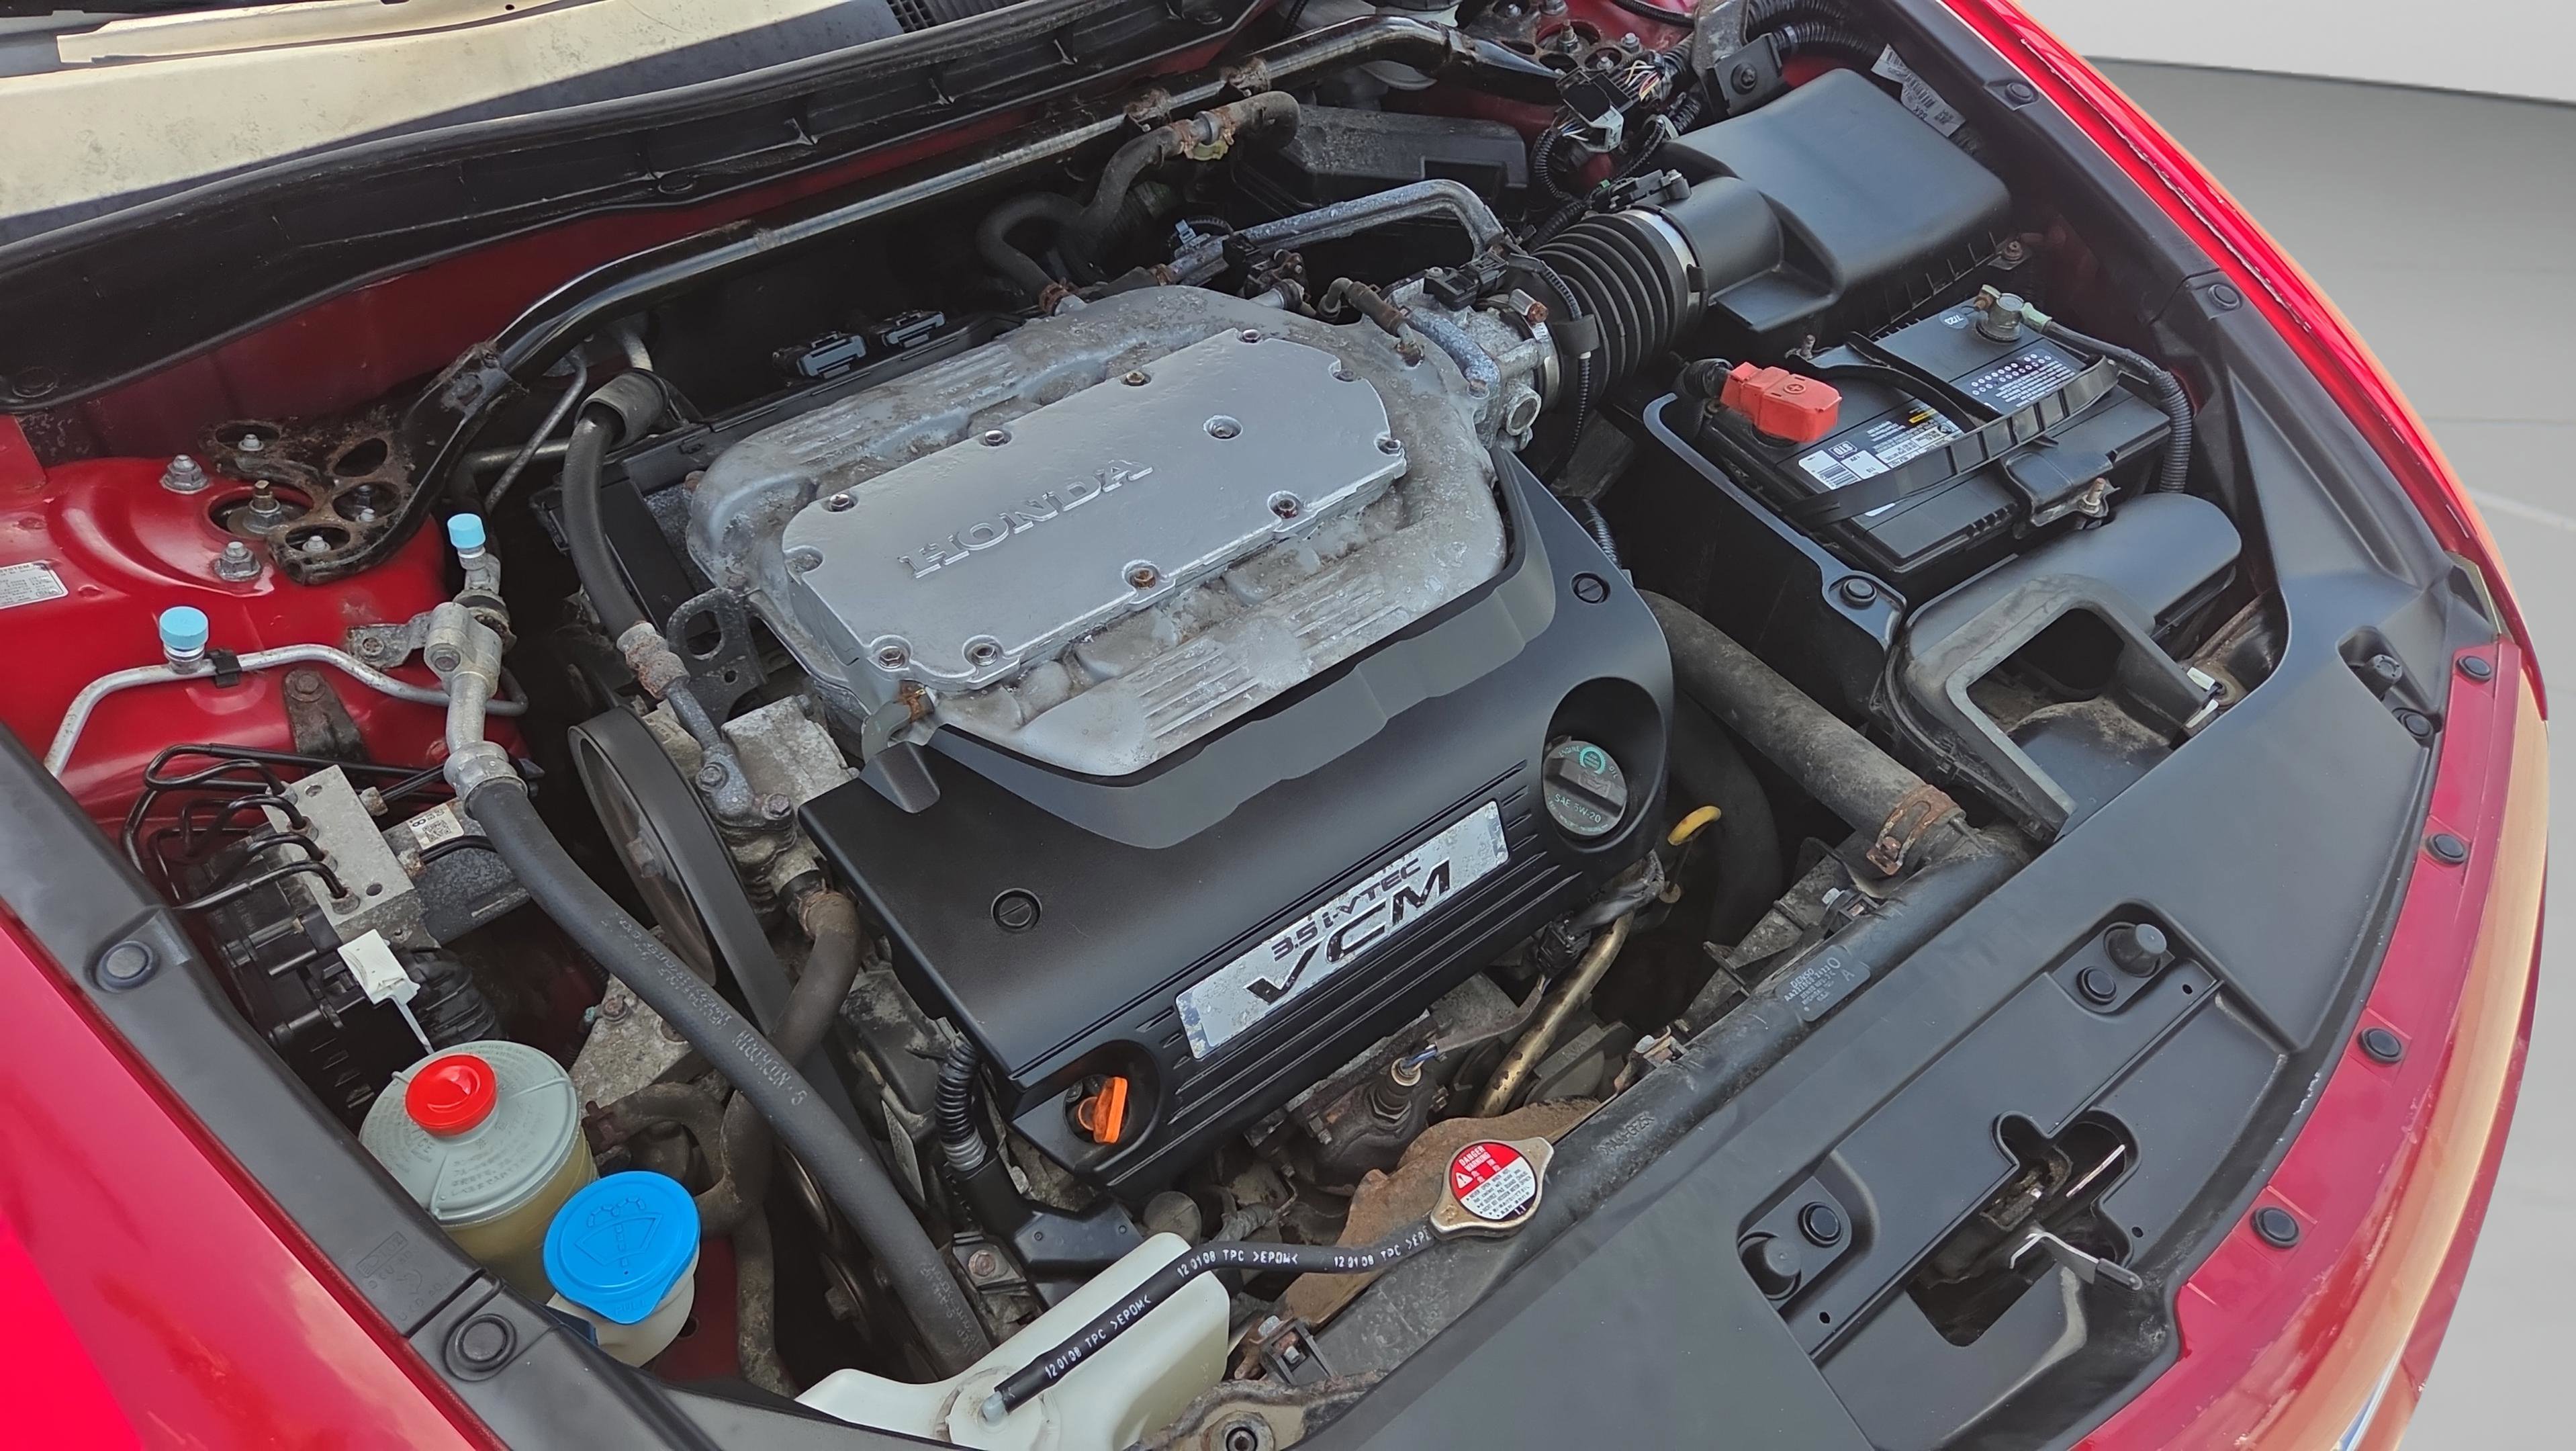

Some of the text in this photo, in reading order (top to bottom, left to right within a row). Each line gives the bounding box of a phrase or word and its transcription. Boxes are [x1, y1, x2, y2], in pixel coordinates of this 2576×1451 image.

[897, 459, 1153, 579] HONDA
[1559, 745, 1618, 779] ENGINE OIL
[1555, 793, 1571, 808] SAE
[1574, 803, 1602, 823] 5W-20
[1271, 857, 1422, 962] 3.5 i-VTEC
[1244, 859, 1451, 1006] VCM
[1790, 968, 1815, 989] DENSO
[1458, 1145, 1486, 1168] DANGER
[1481, 1182, 1490, 1190] OPEN
[1177, 1264, 1189, 1278] 12
[1190, 1255, 1203, 1270] 01
[1203, 1250, 1217, 1264] 08
[1222, 1249, 1244, 1262] TPC
[1334, 1256, 1344, 1268] 12
[1380, 1244, 1401, 1262] TPC
[1045, 1365, 1058, 1379] 12
[1057, 1354, 1069, 1370] 01
[1068, 1346, 1083, 1362] 08
[1085, 1329, 1107, 1348] TPC
